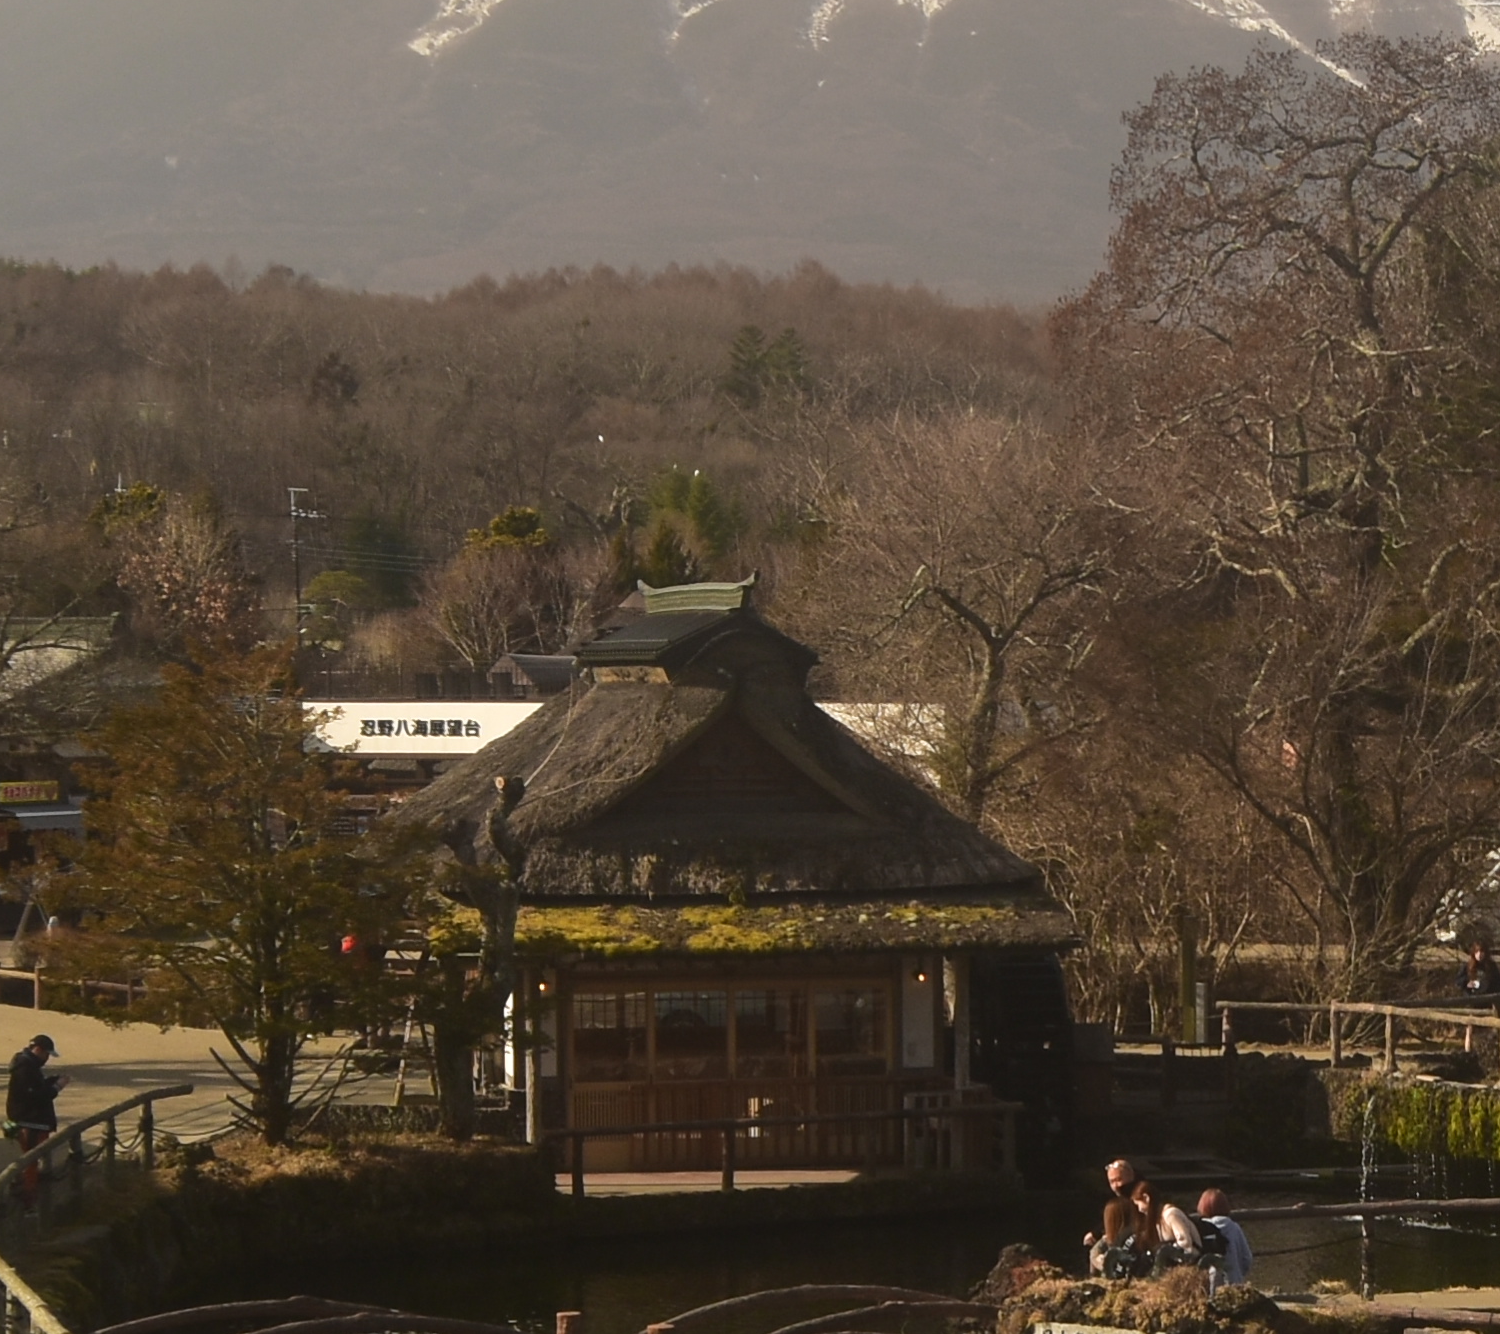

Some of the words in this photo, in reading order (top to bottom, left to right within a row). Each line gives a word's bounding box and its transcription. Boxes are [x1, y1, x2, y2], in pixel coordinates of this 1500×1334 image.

[359, 718, 481, 738] 忍野八海展望台
